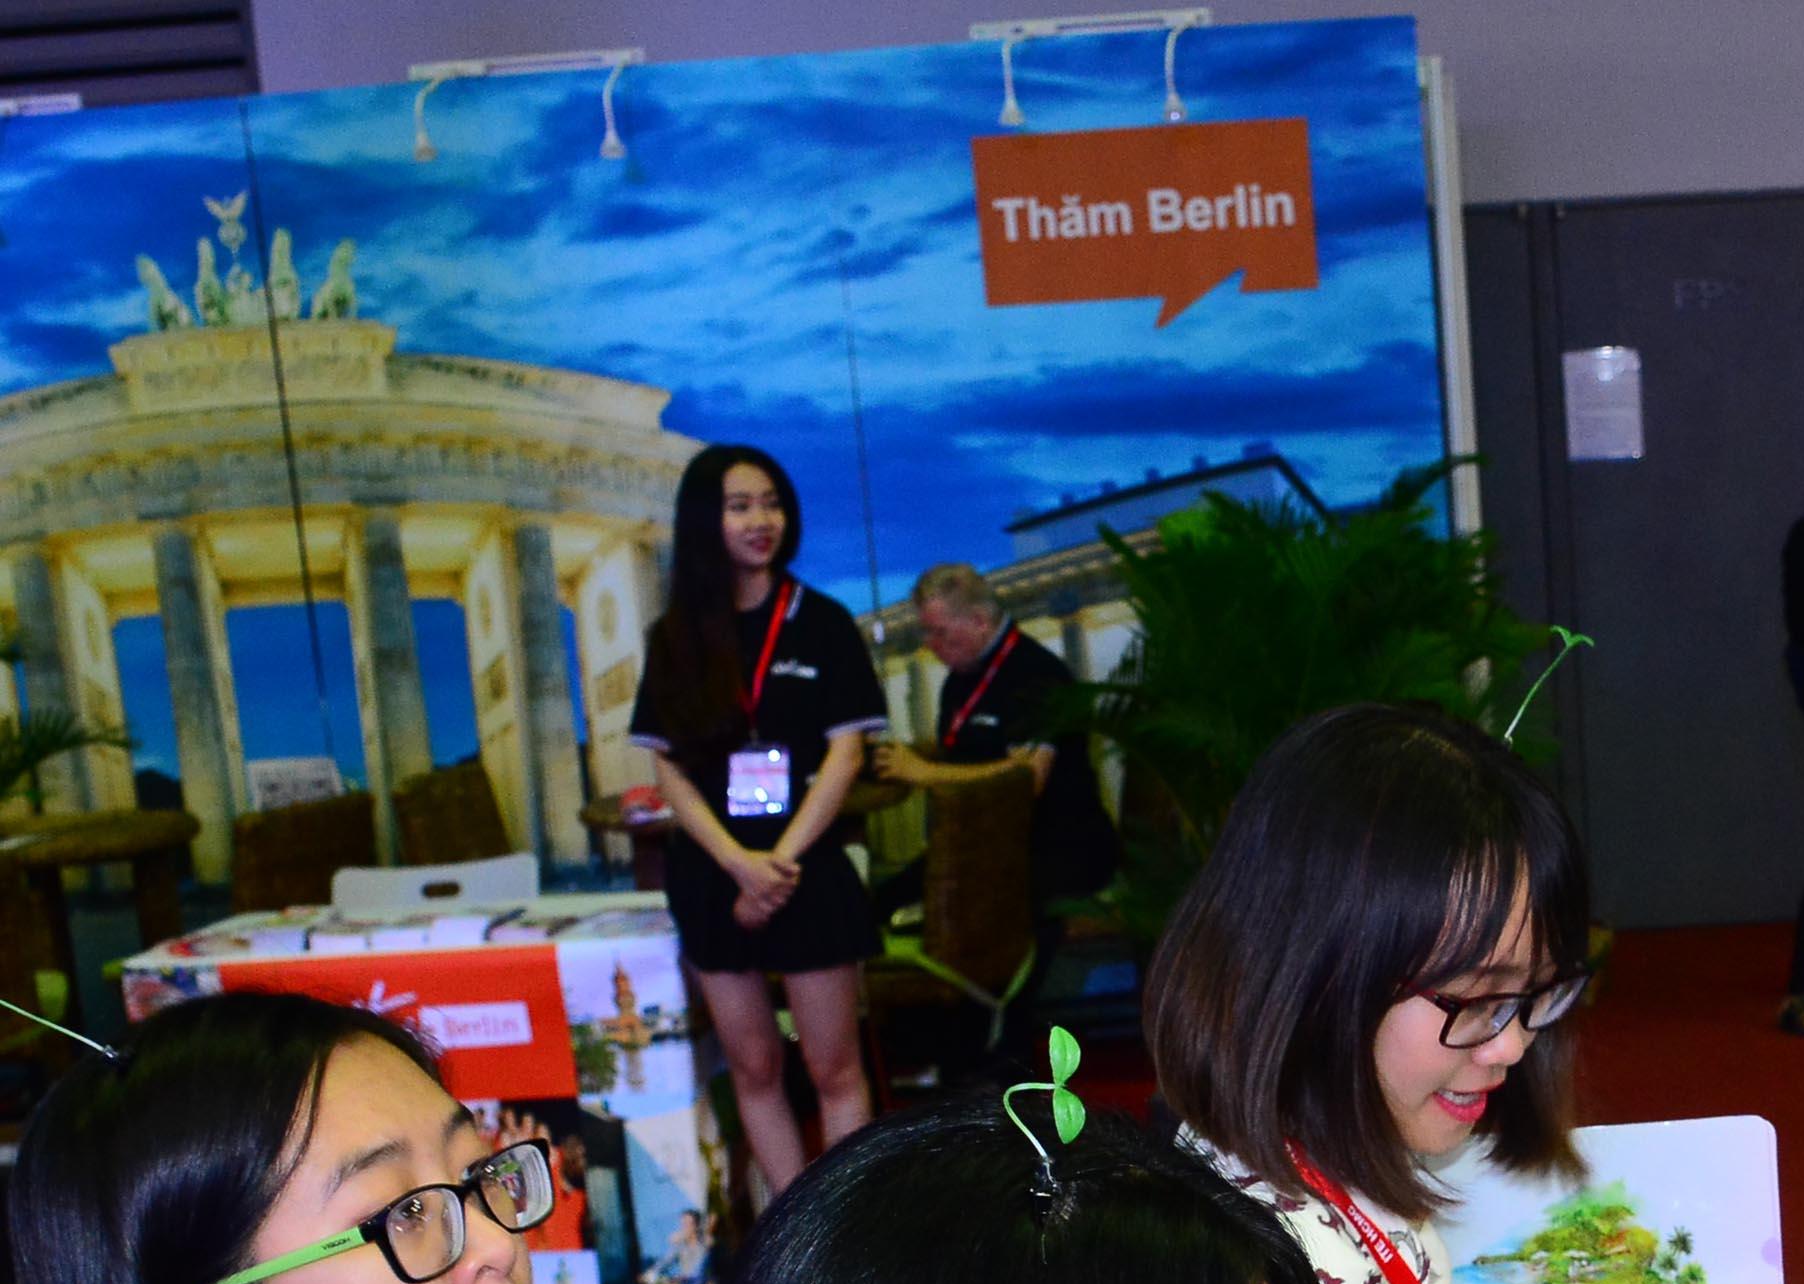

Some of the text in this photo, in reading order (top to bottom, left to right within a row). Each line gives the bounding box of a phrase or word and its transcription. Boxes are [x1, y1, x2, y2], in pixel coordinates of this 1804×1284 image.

[992, 182, 1297, 243] Thăm Berlin
[1347, 1204, 1393, 1263] ITE HCMC
